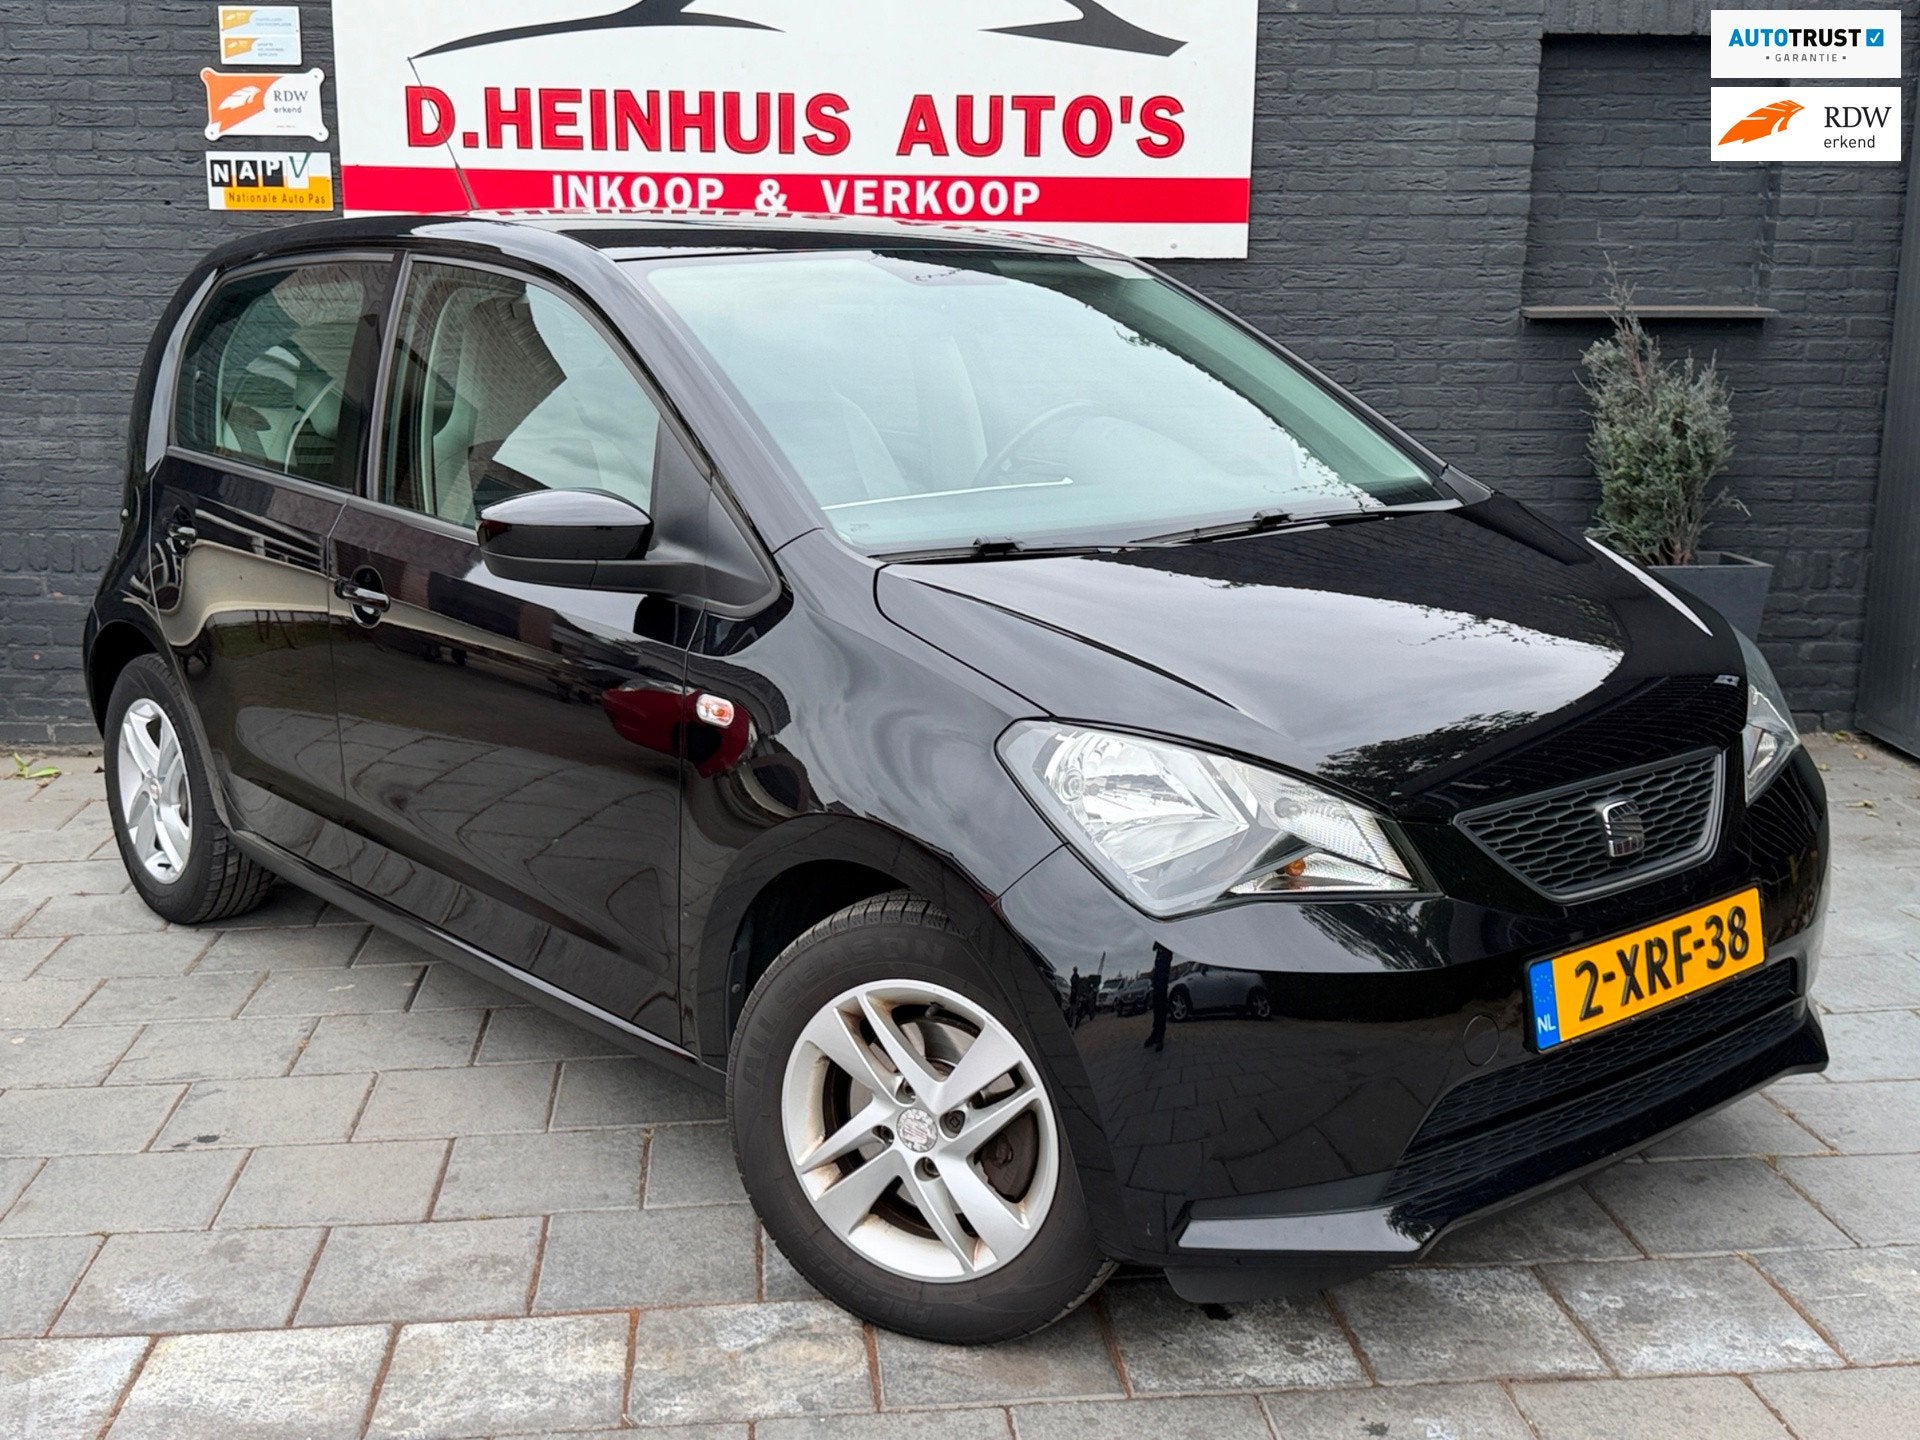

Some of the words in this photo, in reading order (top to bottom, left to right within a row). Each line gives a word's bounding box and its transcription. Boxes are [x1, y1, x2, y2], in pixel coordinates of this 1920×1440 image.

[273, 90, 309, 102] RDW
[274, 106, 302, 114] erkend
[404, 85, 852, 156] D.HEINHUIS
[896, 93, 1186, 159] AUTO'S
[228, 191, 277, 204] Nationale
[282, 193, 305, 204] Auto
[308, 195, 326, 205] Pas
[552, 174, 725, 210] INKOOP
[754, 178, 788, 213] &
[820, 179, 1041, 216] VERKOOP
[1574, 905, 1750, 1022] 2-XRF-38
[1536, 1013, 1556, 1034] NL
